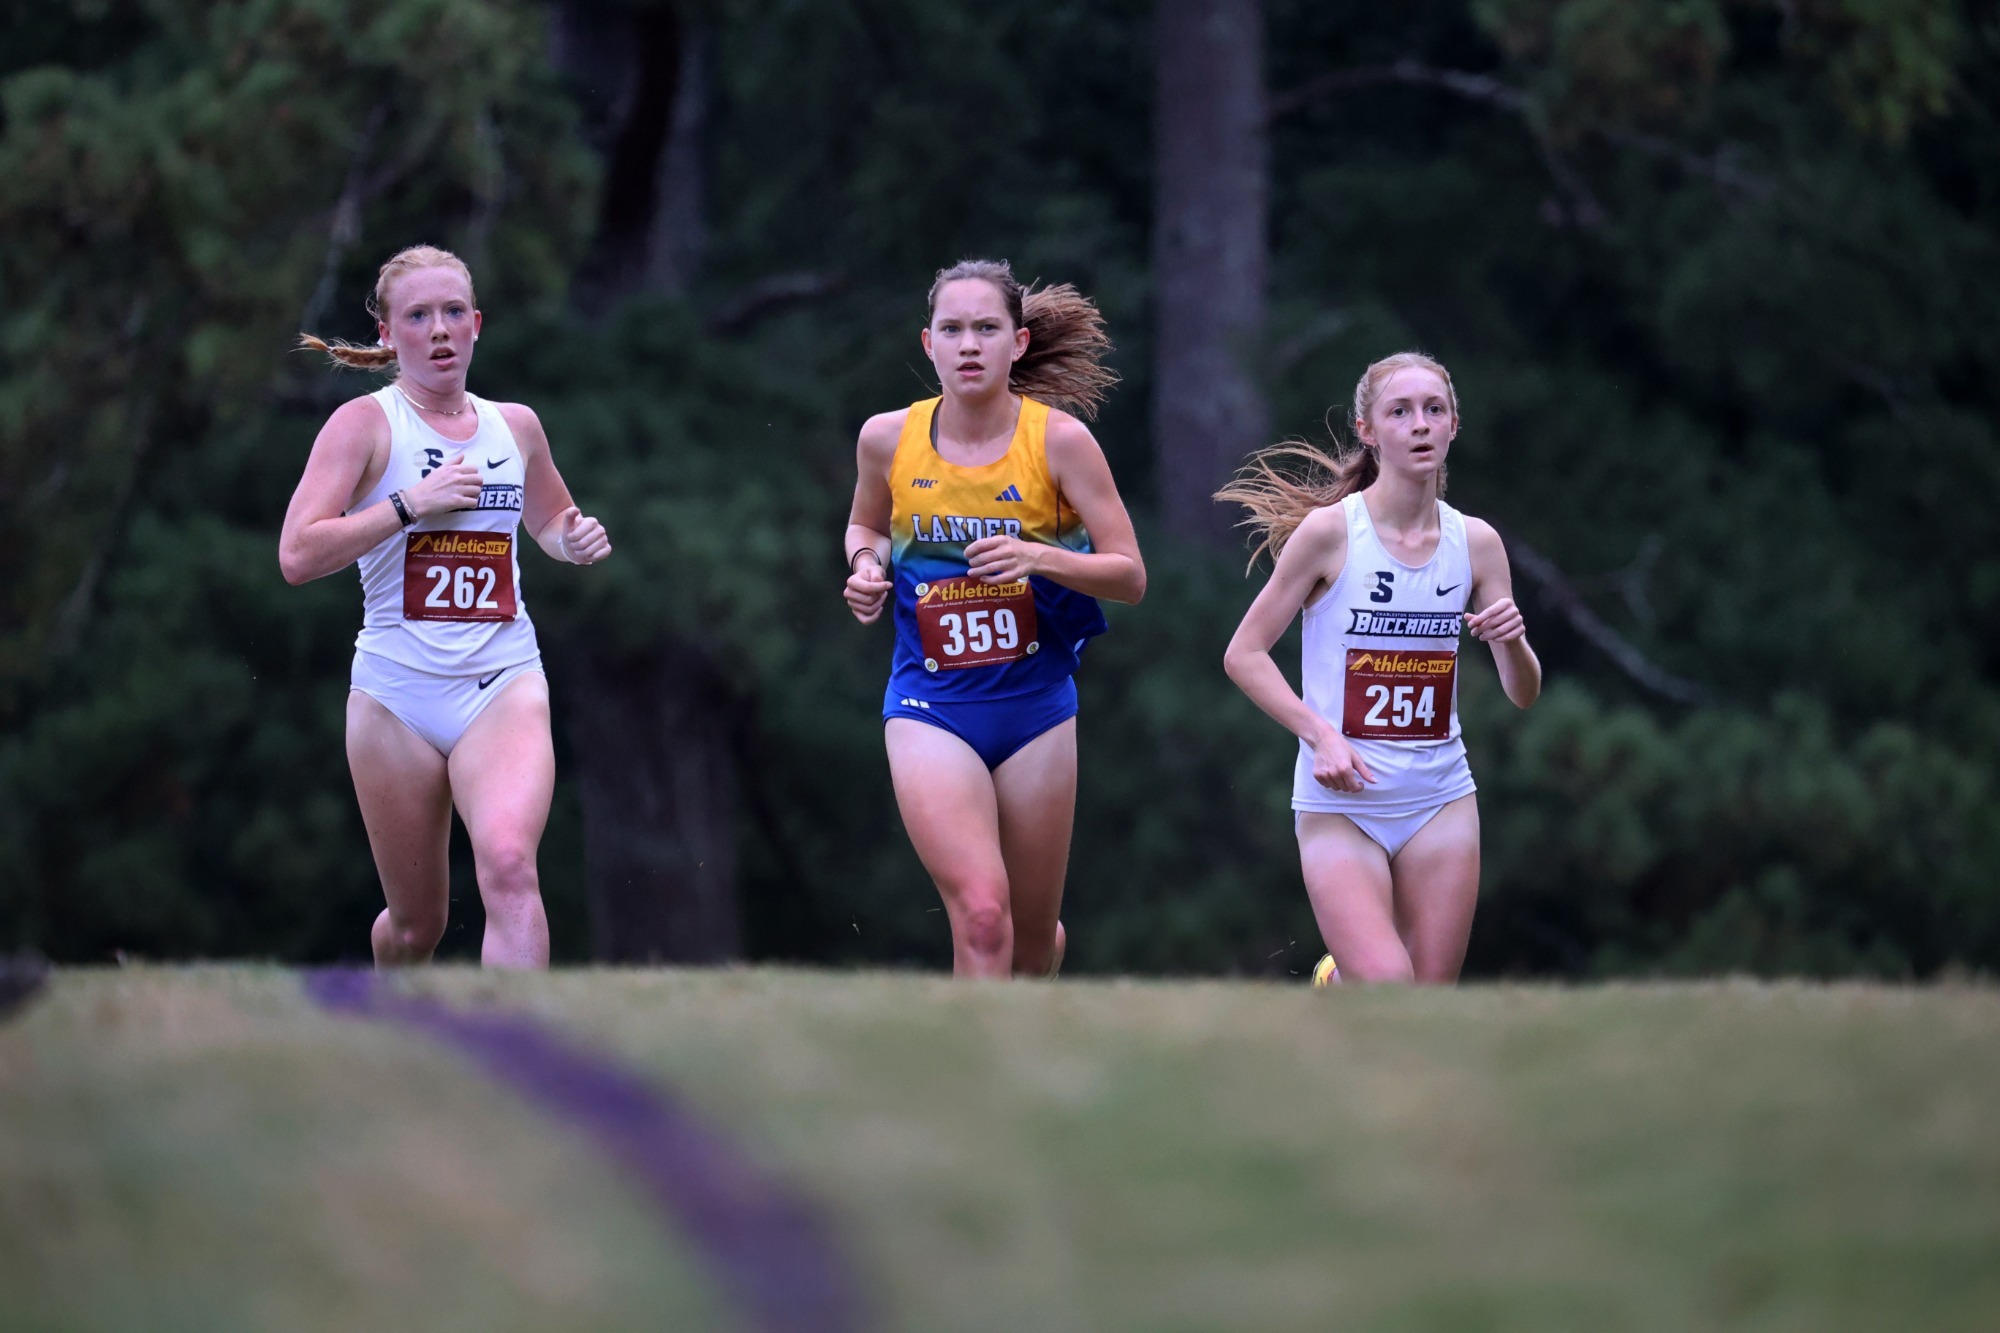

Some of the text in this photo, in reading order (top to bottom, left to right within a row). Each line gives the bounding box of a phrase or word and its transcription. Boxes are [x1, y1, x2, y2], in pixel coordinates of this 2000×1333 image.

[422, 448, 444, 479] S
[911, 478, 939, 489] PBC
[911, 514, 1023, 543] LANDER
[425, 565, 498, 609] 262
[1370, 571, 1395, 603] S
[939, 608, 1019, 657] 359
[1351, 611, 1462, 636] BUCCANEERS
[1364, 684, 1436, 728] 254
